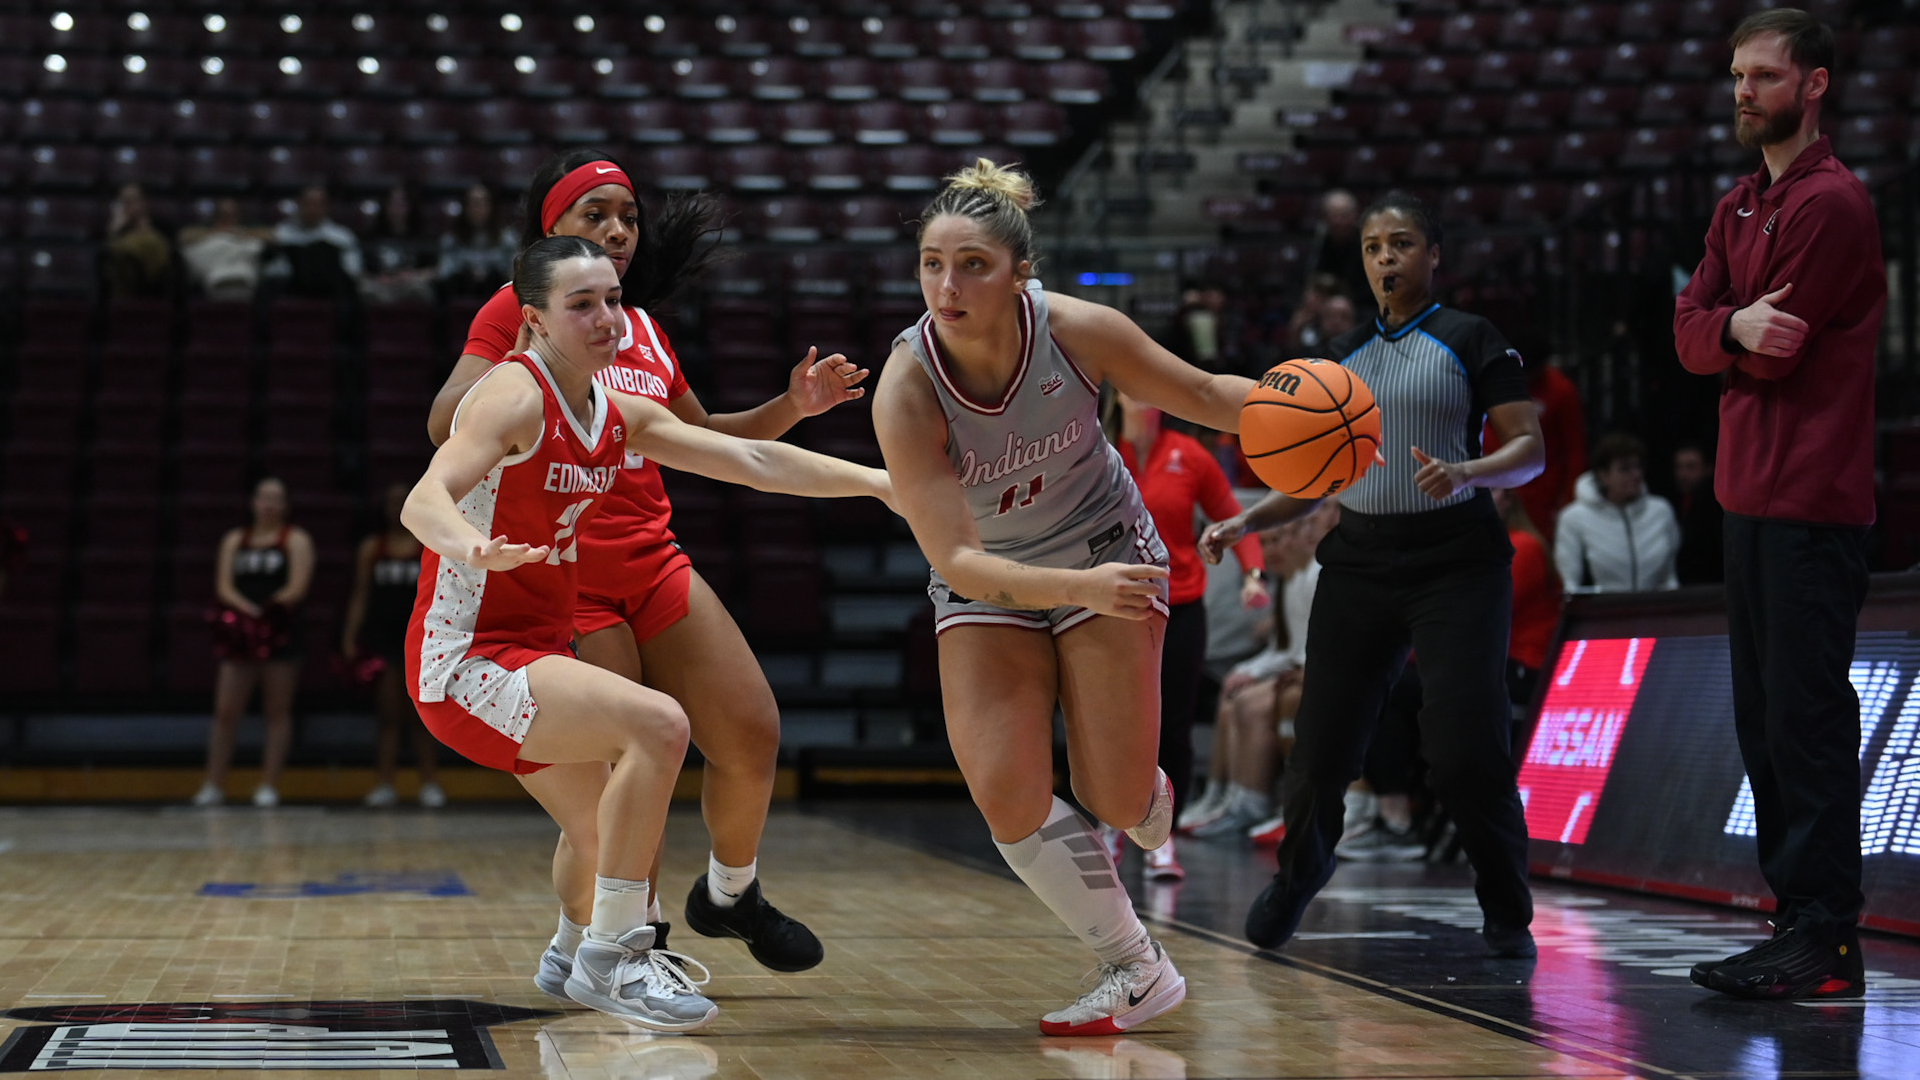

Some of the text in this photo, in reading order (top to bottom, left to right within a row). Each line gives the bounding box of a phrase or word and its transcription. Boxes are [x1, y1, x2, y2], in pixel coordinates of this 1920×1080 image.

[597, 365, 668, 399] INBORO
[1040, 374, 1062, 392] PSAC
[1259, 371, 1301, 396] Wil
[959, 418, 1083, 488] Indiana
[543, 462, 617, 494] EDINBOR
[1526, 708, 1624, 767] NISSAN
